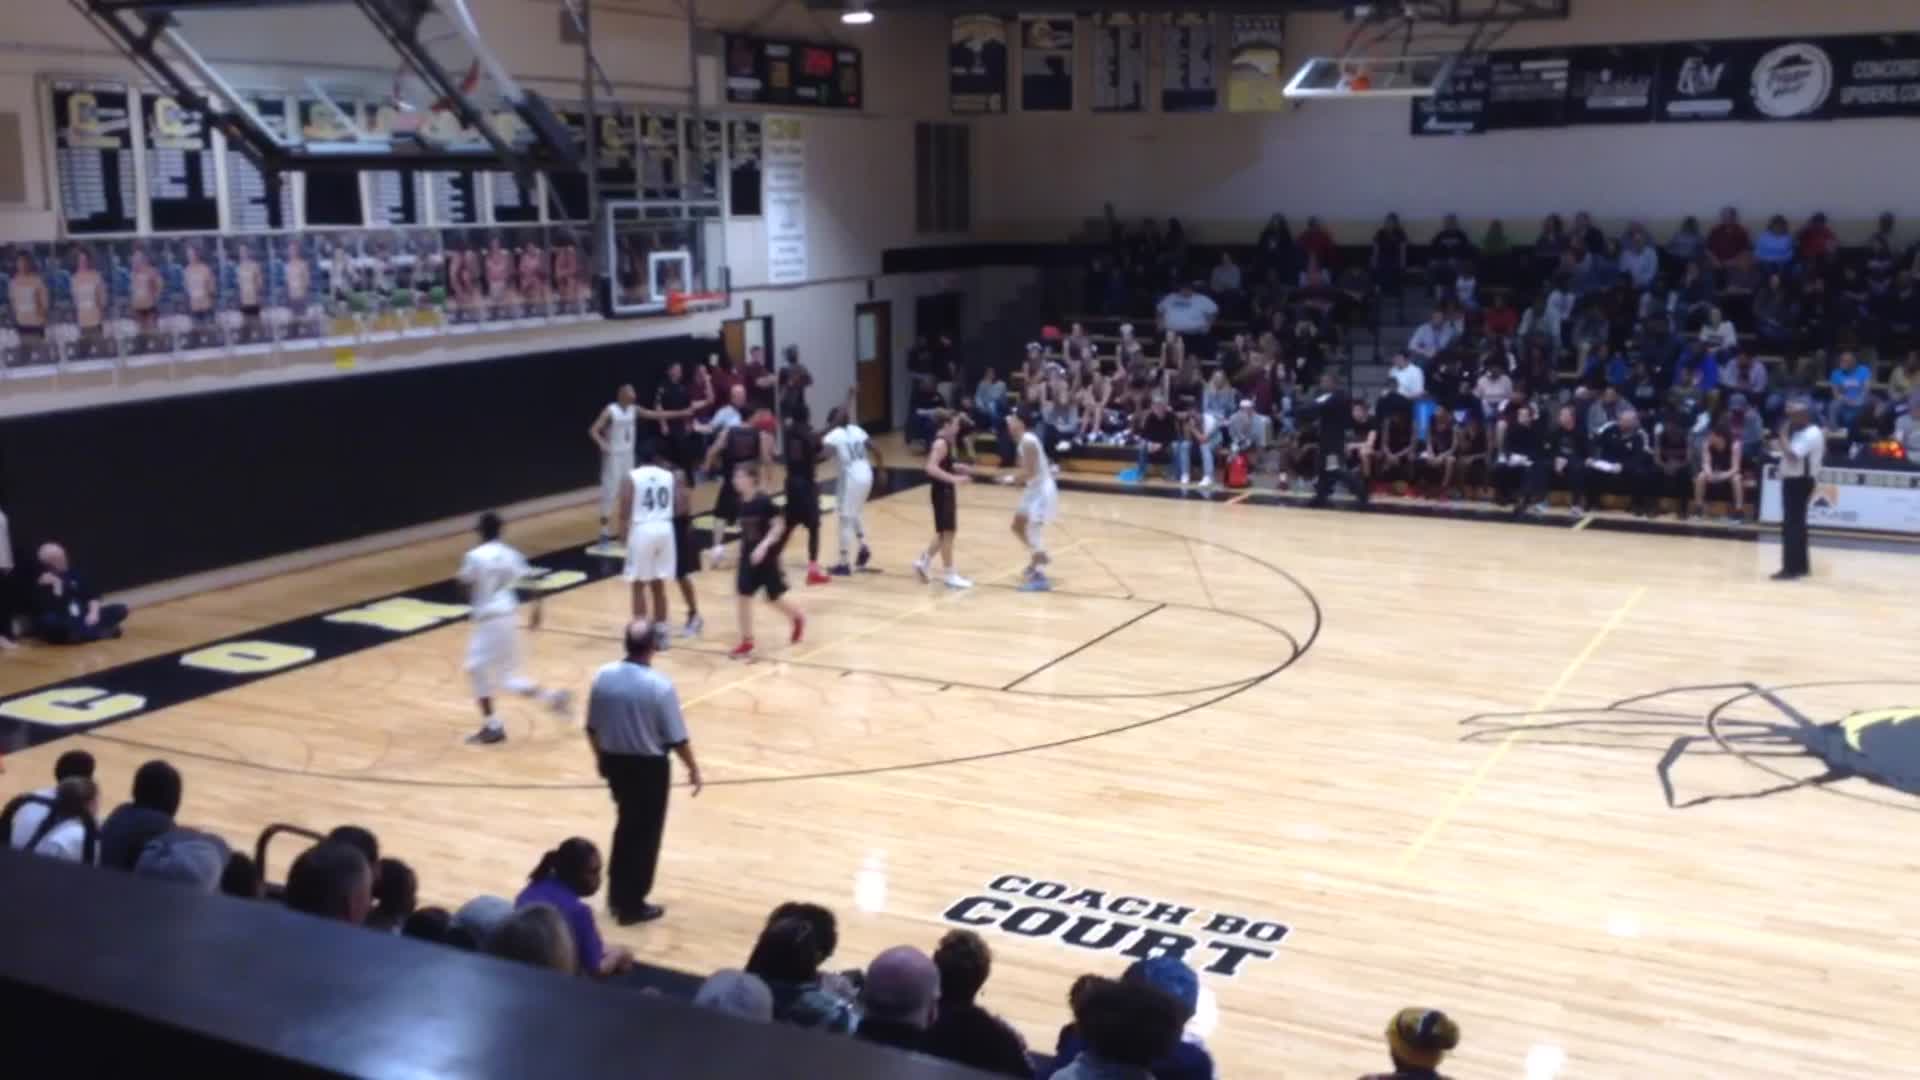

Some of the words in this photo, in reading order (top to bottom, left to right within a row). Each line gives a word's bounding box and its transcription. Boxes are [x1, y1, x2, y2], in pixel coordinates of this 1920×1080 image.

[642, 484, 671, 511] 40
[944, 896, 1273, 975] COURT
[988, 874, 1194, 926] COACH
[1202, 913, 1288, 943] BO
